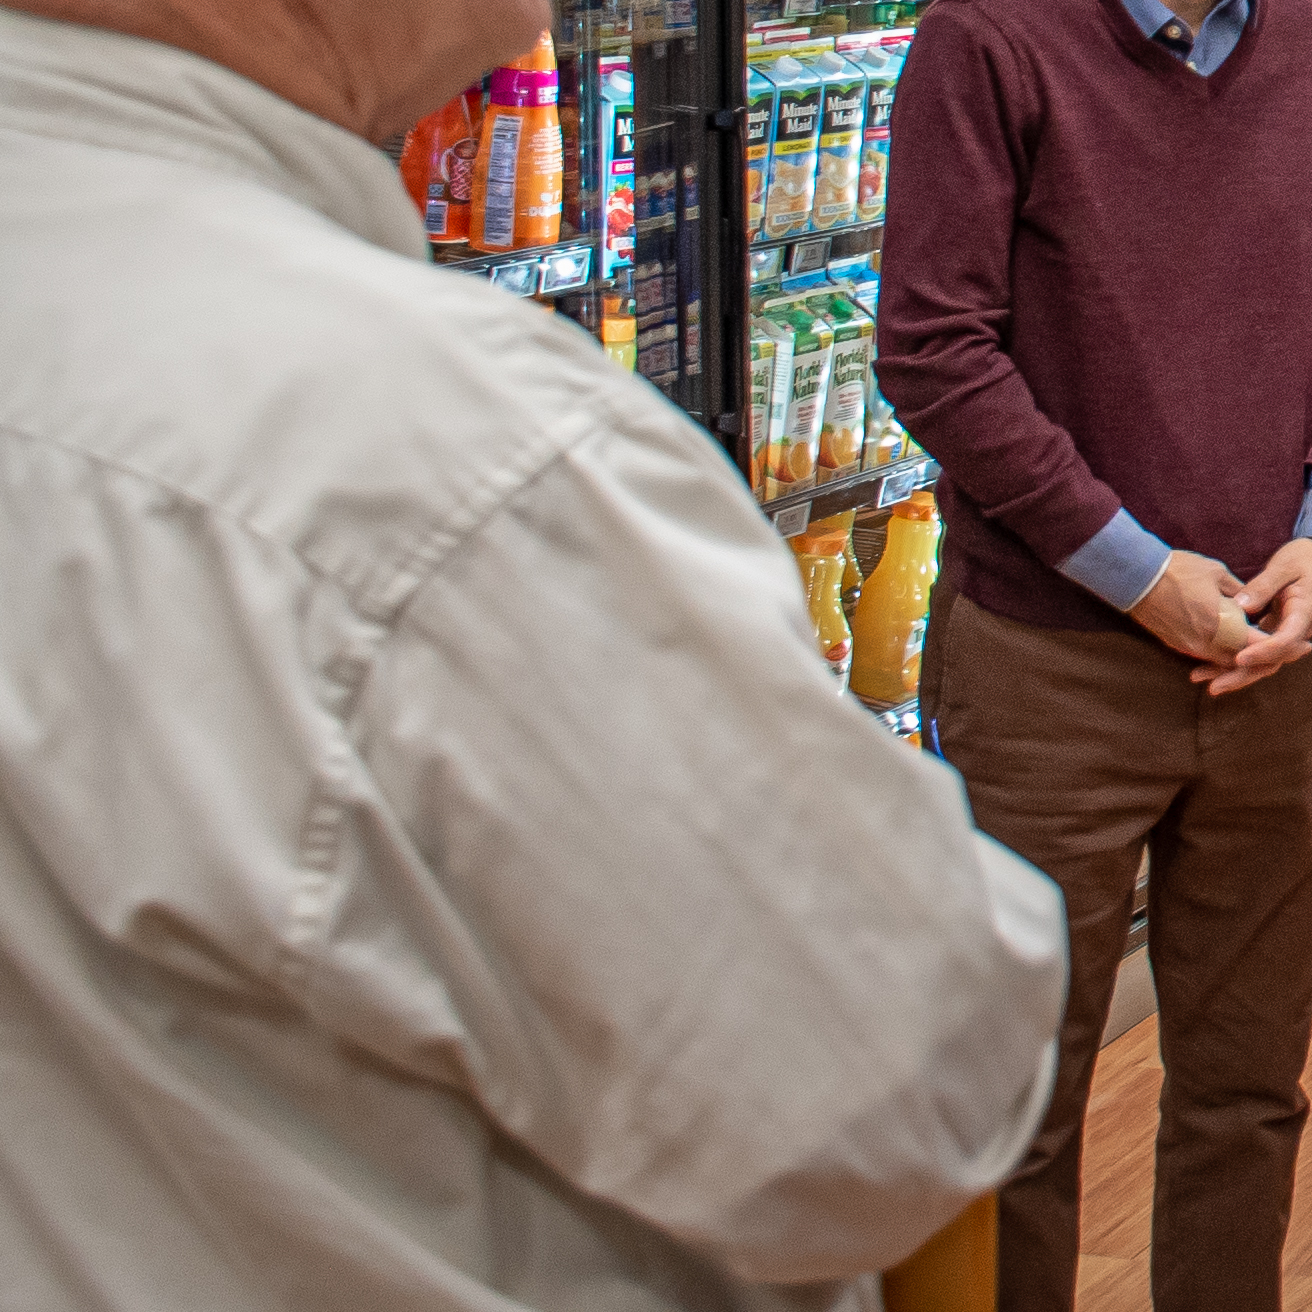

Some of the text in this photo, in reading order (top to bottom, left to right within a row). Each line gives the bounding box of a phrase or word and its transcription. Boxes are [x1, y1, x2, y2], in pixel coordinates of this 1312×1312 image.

[781, 102, 817, 119] Minute
[826, 95, 862, 112] Minute
[785, 115, 813, 134] Maid
[831, 109, 859, 127] Maid
